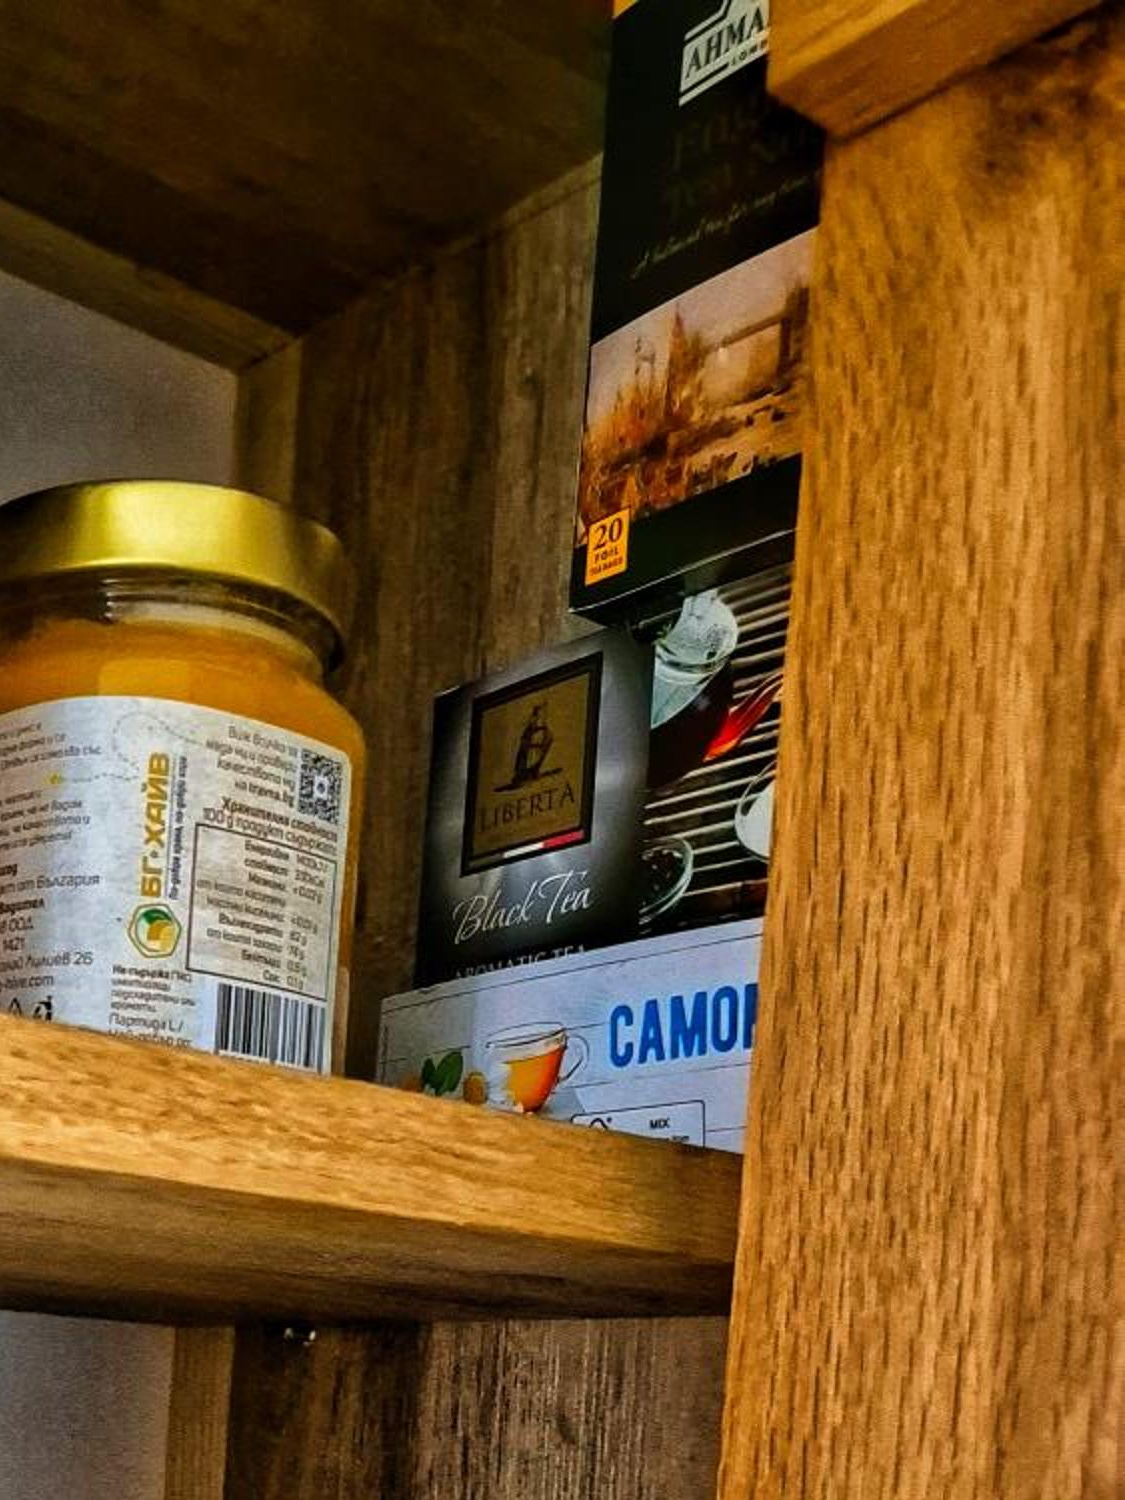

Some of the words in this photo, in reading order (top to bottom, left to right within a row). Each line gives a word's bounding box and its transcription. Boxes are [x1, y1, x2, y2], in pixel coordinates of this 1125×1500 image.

[685, 7, 766, 79] AHMA
[594, 517, 623, 551] 20
[453, 880, 539, 945] Black
[538, 869, 593, 925] Tea
